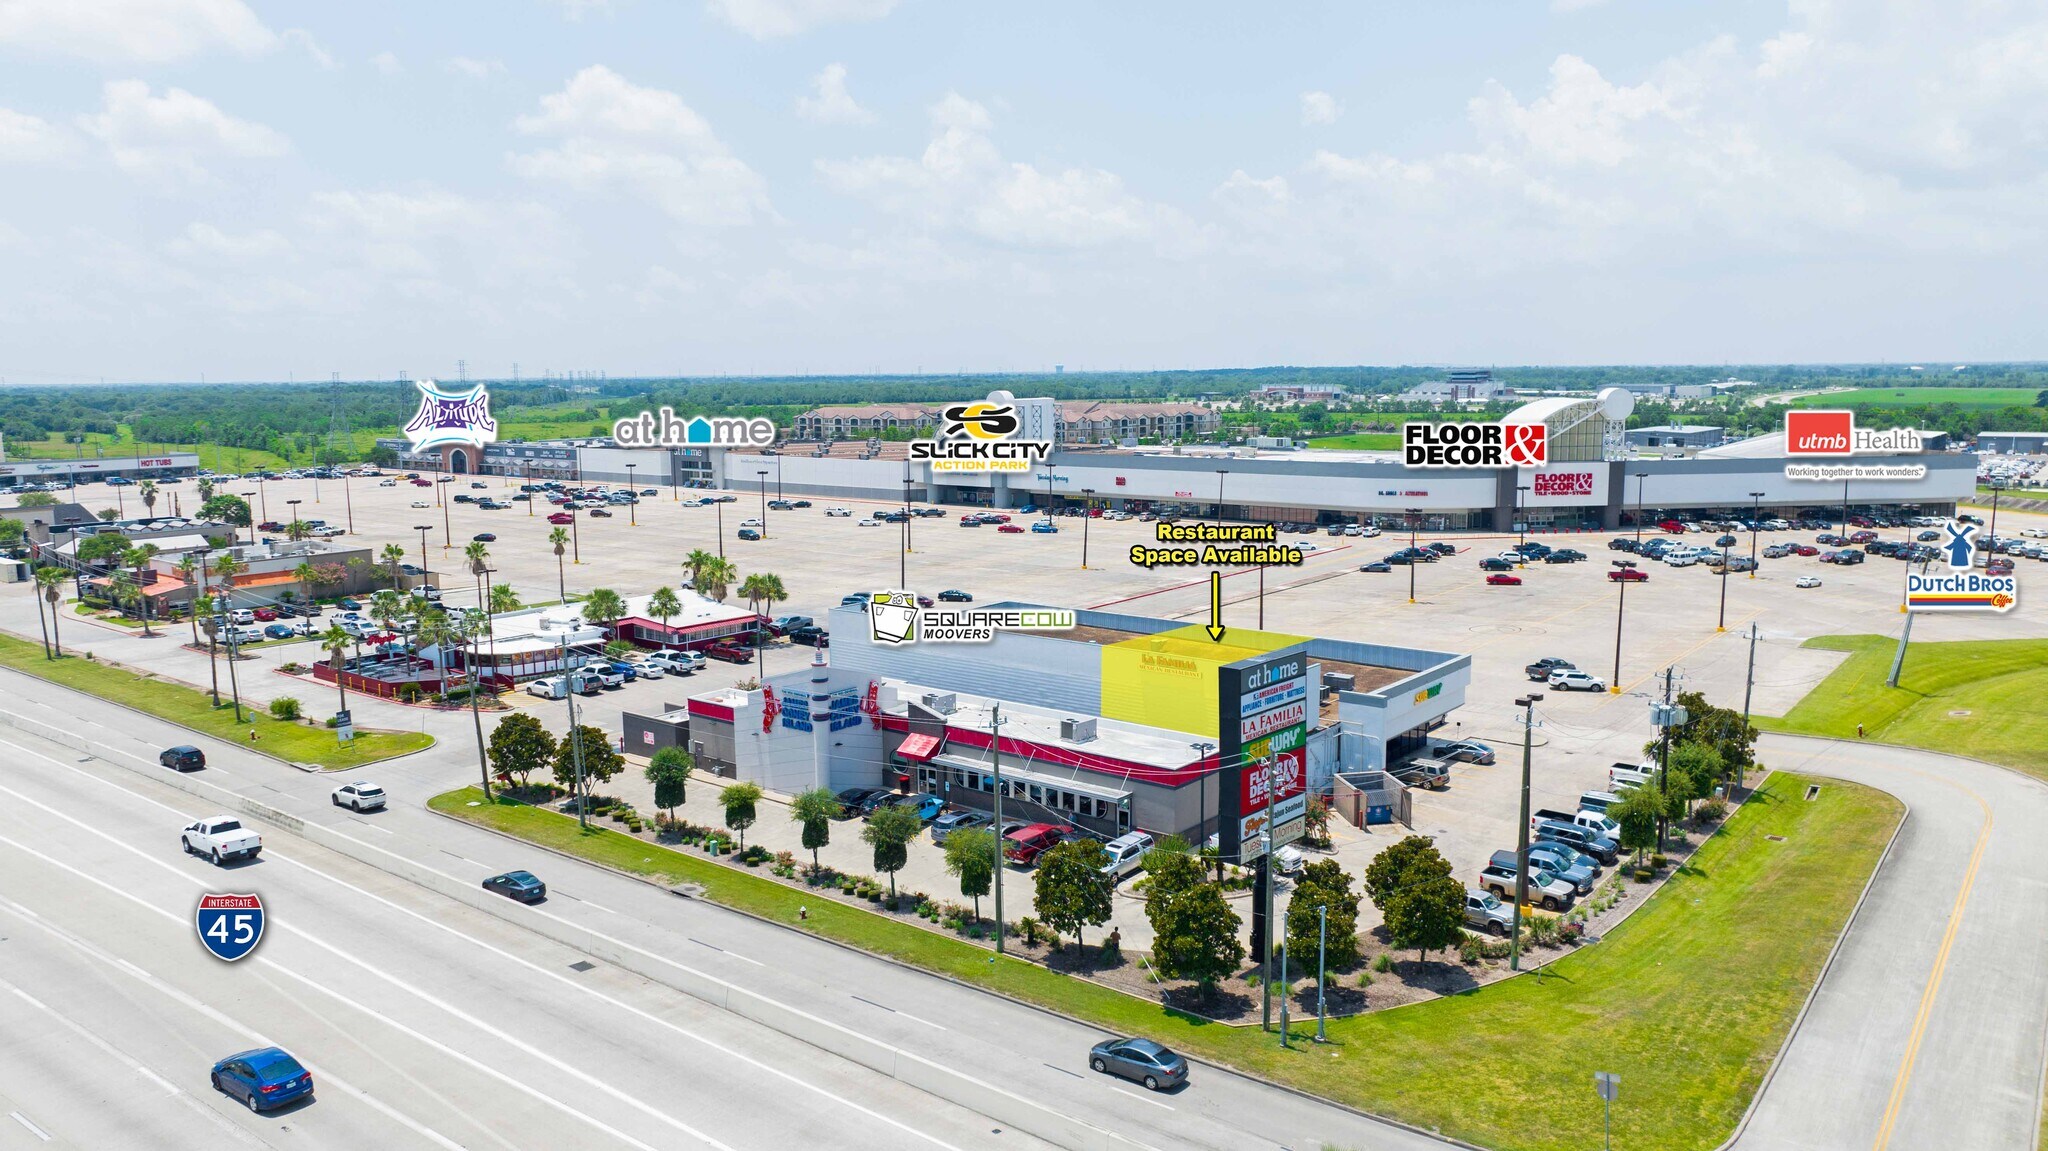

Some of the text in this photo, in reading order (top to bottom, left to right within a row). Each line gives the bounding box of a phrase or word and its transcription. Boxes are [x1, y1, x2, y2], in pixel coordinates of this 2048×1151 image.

[155, 458, 172, 466] TUBS
[1535, 473, 1575, 482] FLOOR
[1535, 482, 1575, 491] DECOR
[1248, 677, 1261, 689] at
[1259, 681, 1295, 698] AMERICAN FREIGHT
[1242, 686, 1305, 713] APPLIANCE FURNITURE MATTRESS
[1413, 682, 1443, 706] SUBWAY
[1242, 705, 1303, 735] LA FAMILIA
[1245, 717, 1301, 740] MEXICAN RESTAURANT
[1249, 796, 1261, 806] TILE
[1285, 799, 1304, 814] Seafood
[1274, 820, 1302, 840] Morning
